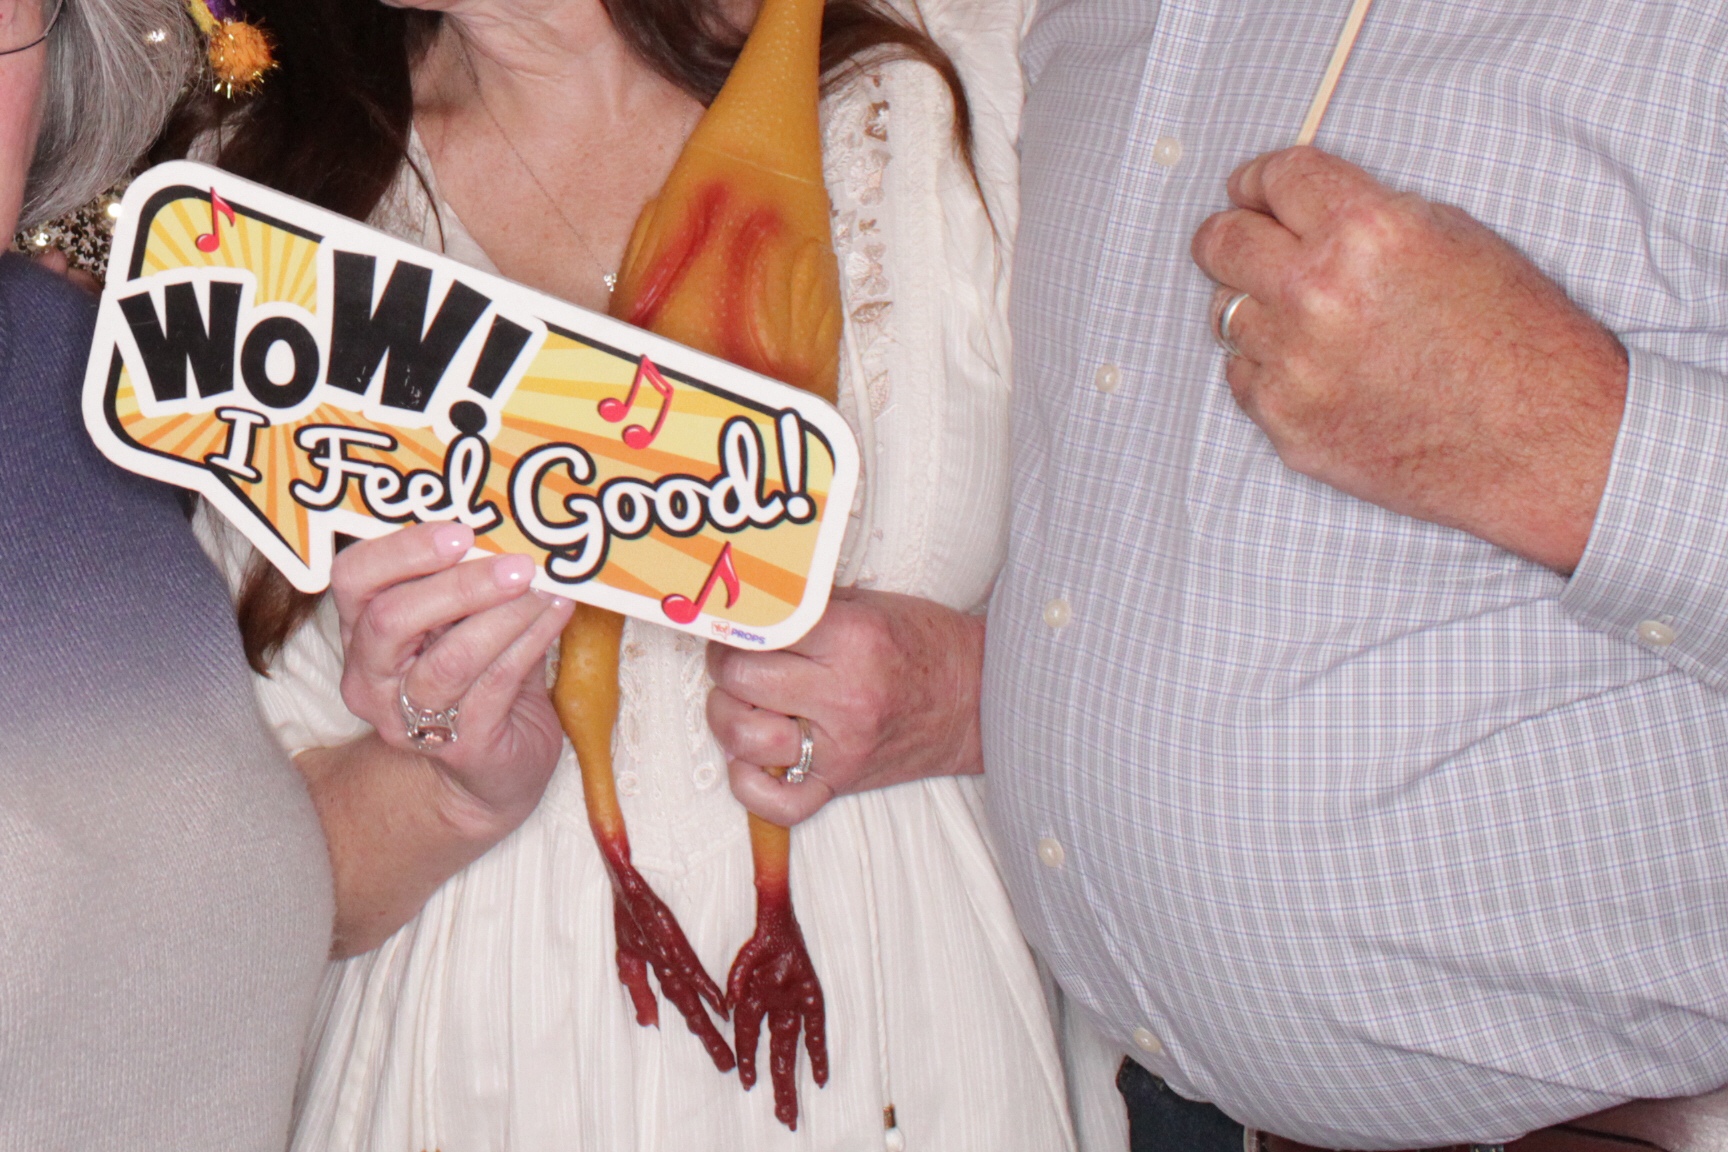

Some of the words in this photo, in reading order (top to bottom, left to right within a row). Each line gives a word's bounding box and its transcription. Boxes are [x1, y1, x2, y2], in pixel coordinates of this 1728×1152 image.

[204, 406, 270, 484] I
[289, 422, 503, 535] Feel
[508, 408, 818, 584] Good!
[731, 628, 766, 645] PROPS
